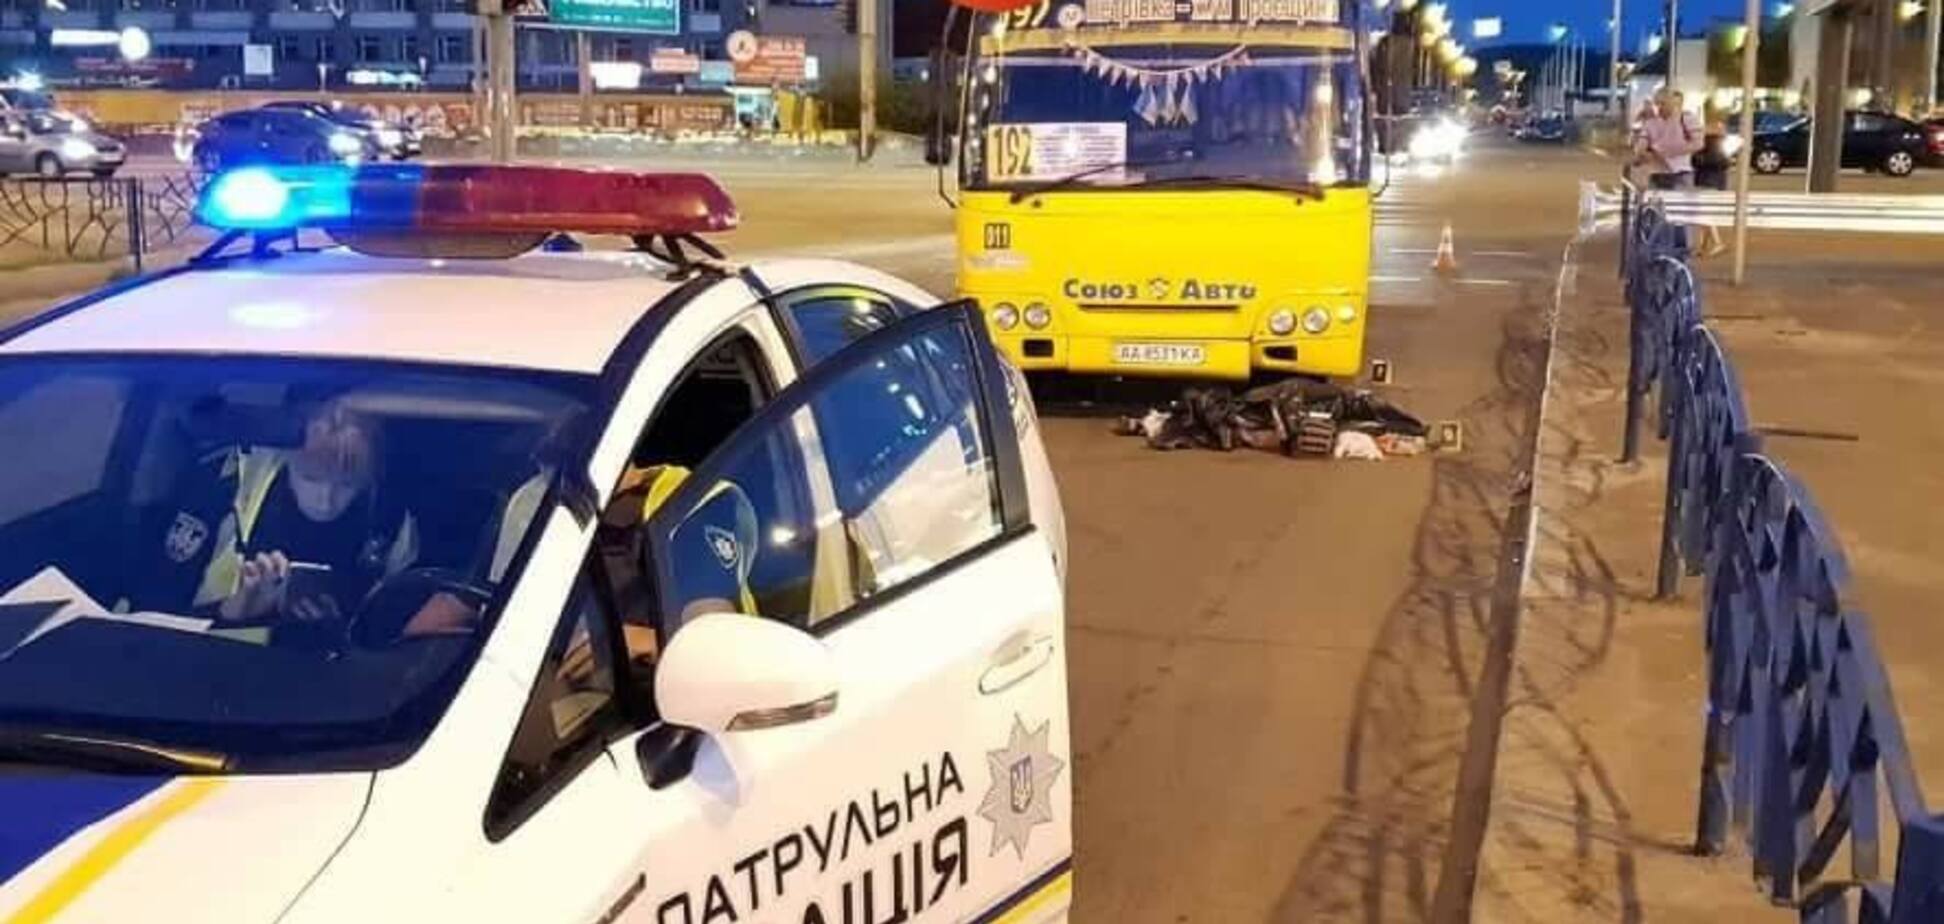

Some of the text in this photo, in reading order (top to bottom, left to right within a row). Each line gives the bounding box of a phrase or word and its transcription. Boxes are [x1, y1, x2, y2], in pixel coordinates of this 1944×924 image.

[993, 126, 1032, 175] 192
[1064, 278, 1256, 300] Союз Авто
[657, 751, 964, 924] ПАТРУЛЬНА
[801, 815, 968, 924] ІЦІЯ
